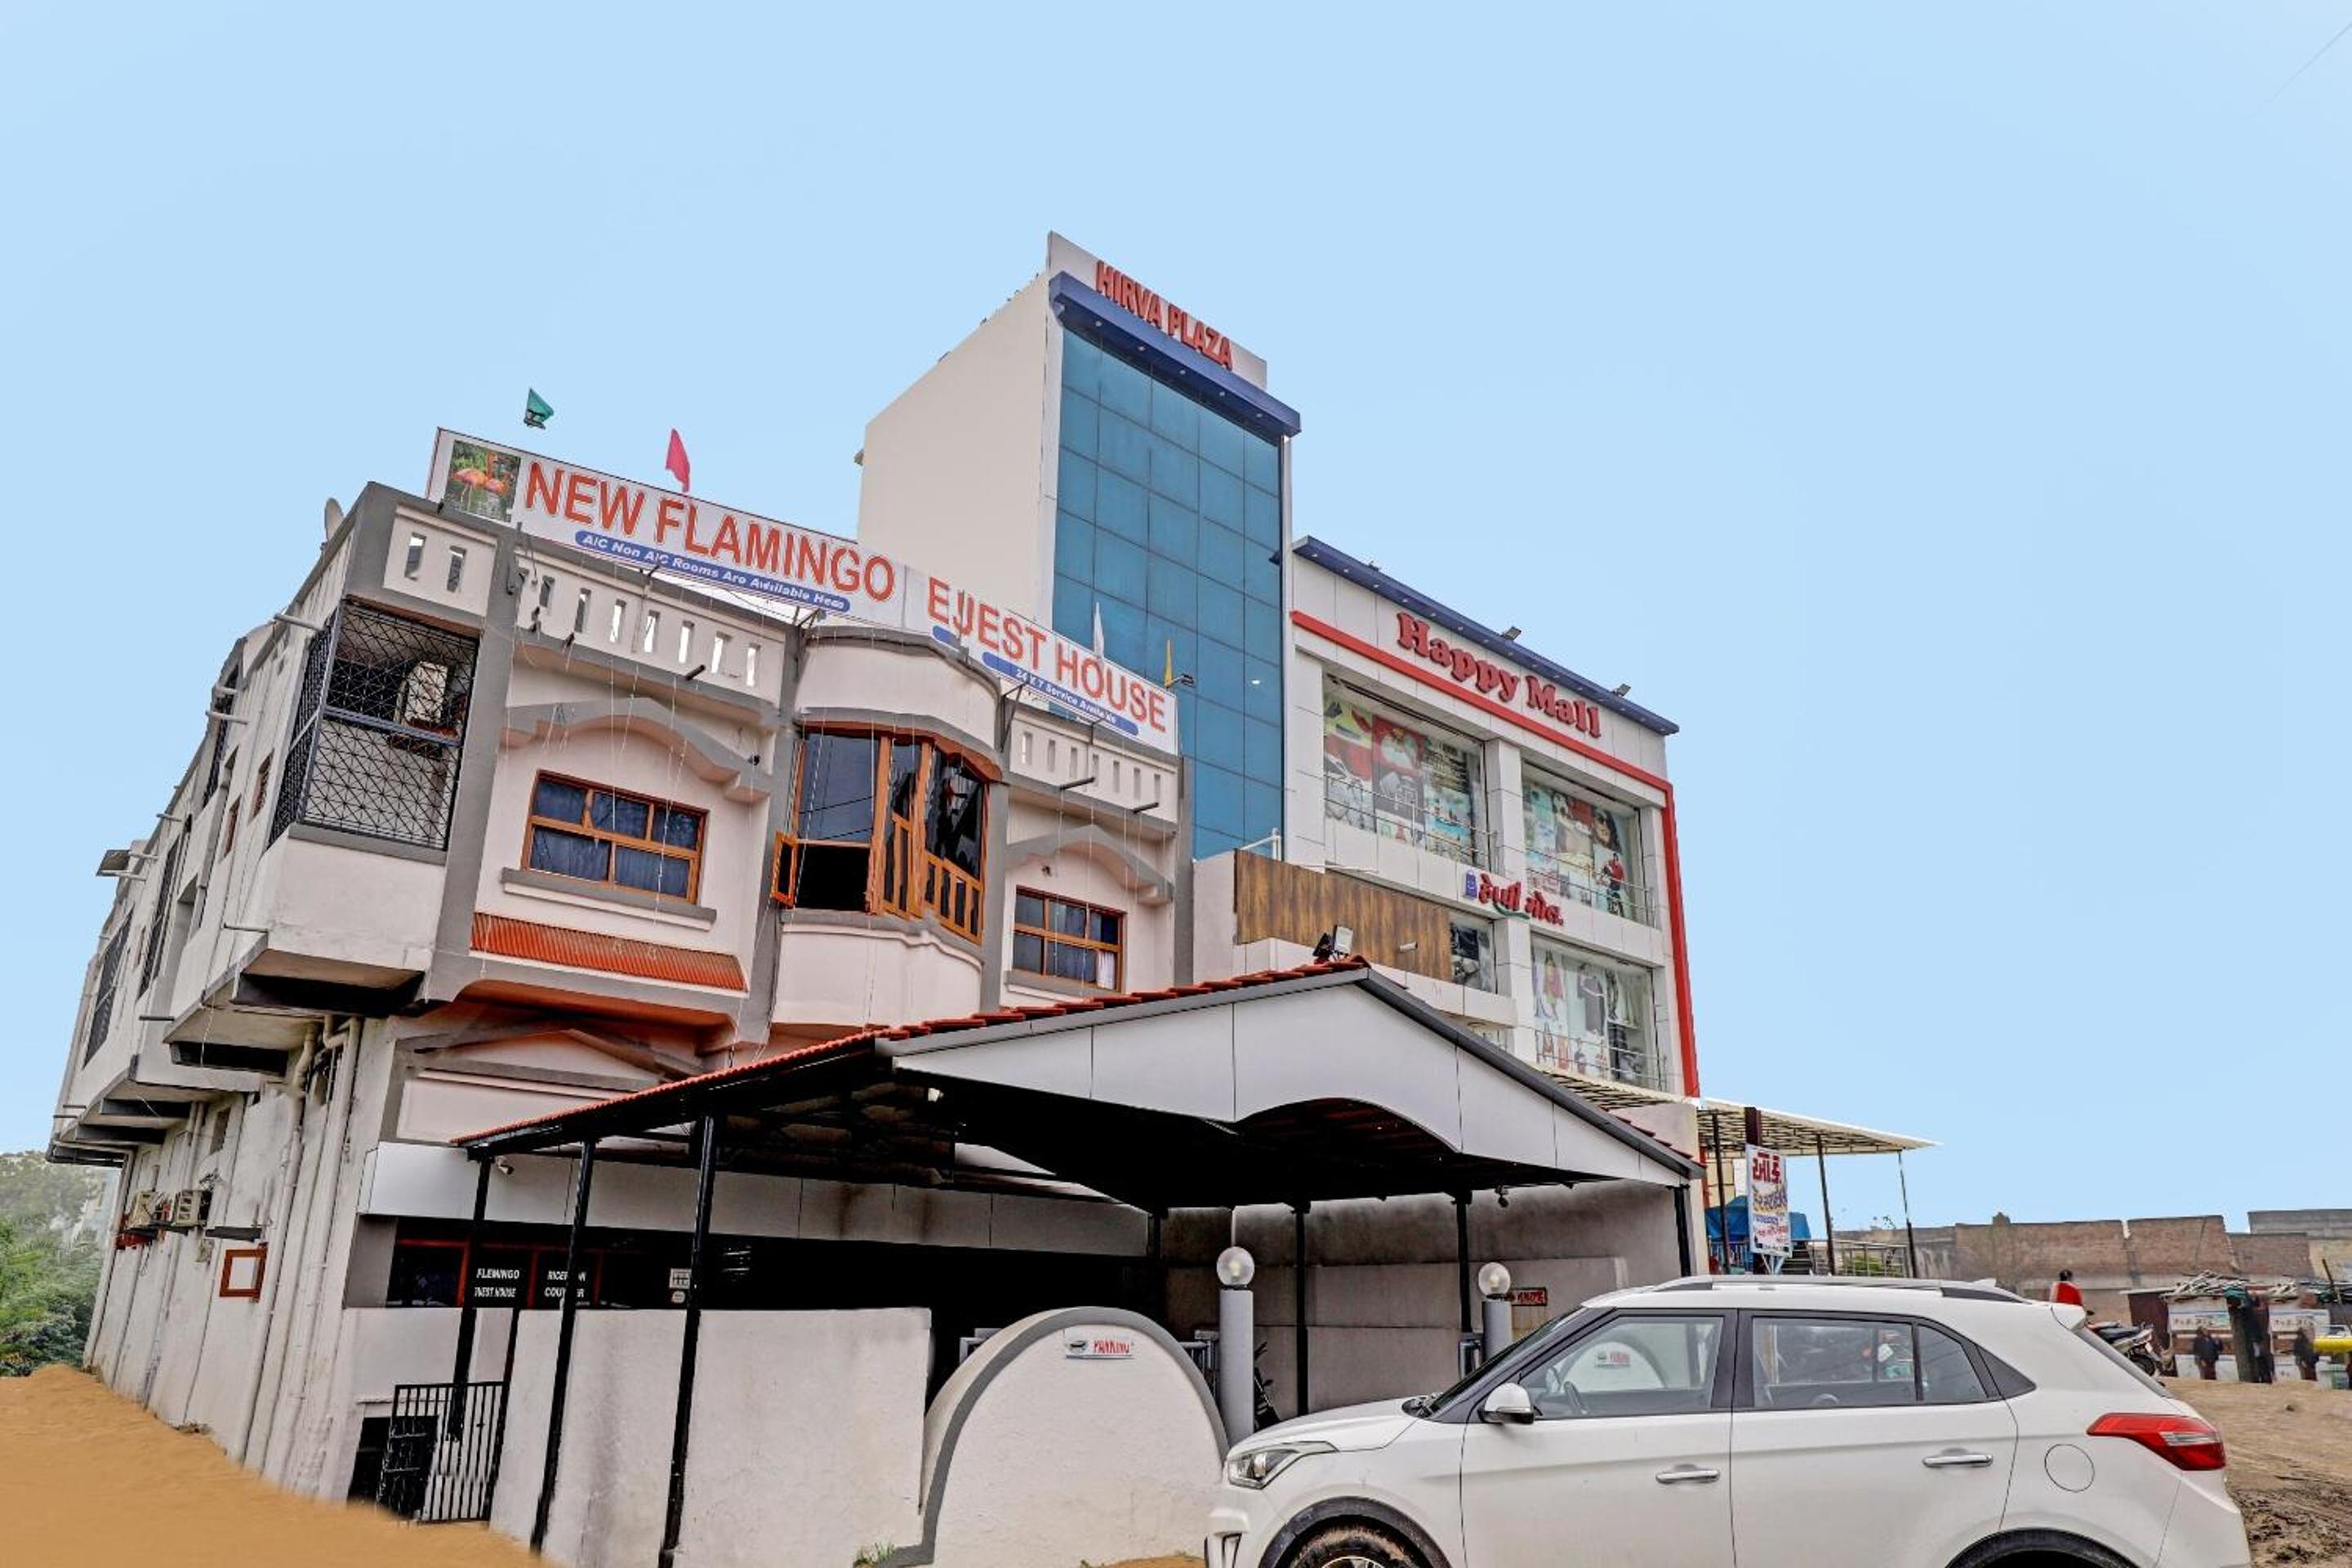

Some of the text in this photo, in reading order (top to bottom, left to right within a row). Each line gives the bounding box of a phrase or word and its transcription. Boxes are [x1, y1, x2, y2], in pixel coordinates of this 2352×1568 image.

[1096, 260, 1232, 372] HIRVA PLAZA
[525, 461, 645, 537] NEW
[656, 498, 895, 602] FLAMINGO
[1057, 642, 1168, 733] HOUSE
[612, 542, 640, 557] Non
[672, 558, 719, 578] Rooms
[1396, 612, 1601, 738] Happy Mall
